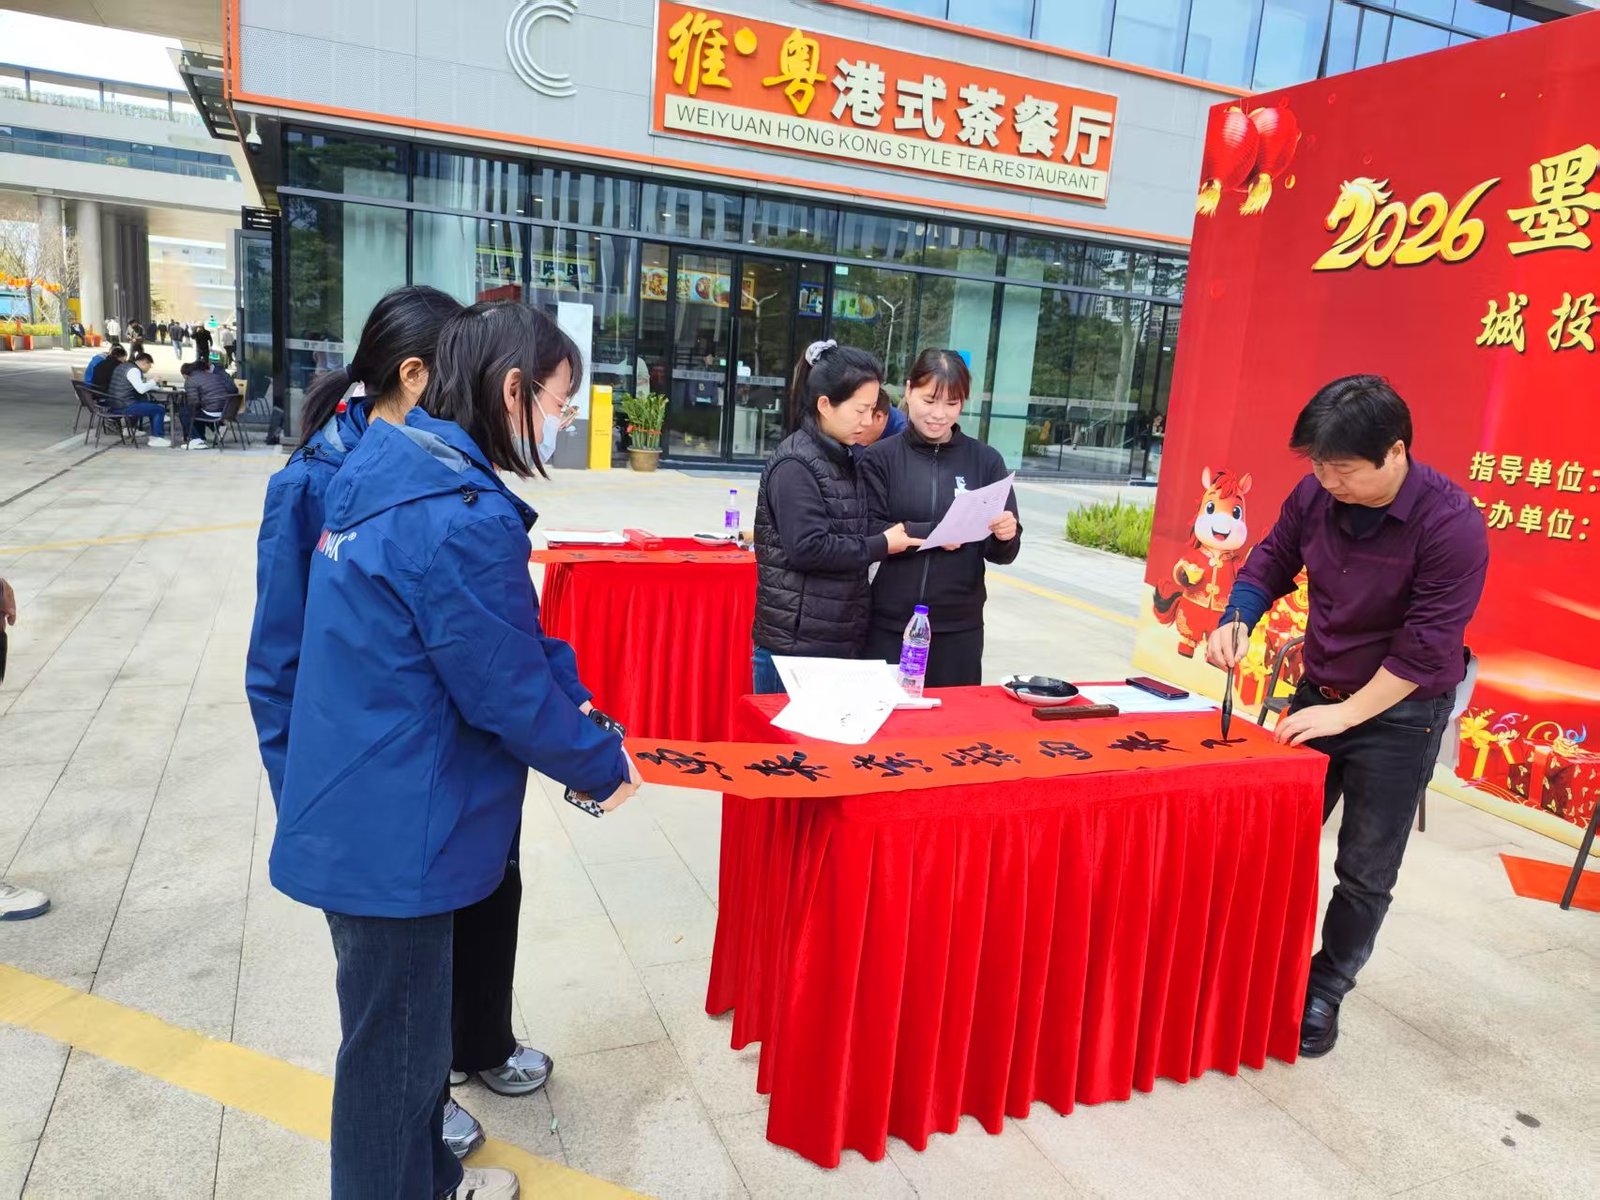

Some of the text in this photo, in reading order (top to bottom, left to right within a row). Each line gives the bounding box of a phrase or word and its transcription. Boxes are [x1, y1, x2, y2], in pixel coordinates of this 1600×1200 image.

[677, 104, 1100, 190] WEIYUAN HONG KONG STYLE TEA RESTAURANT
[1311, 176, 1501, 270] 2026
